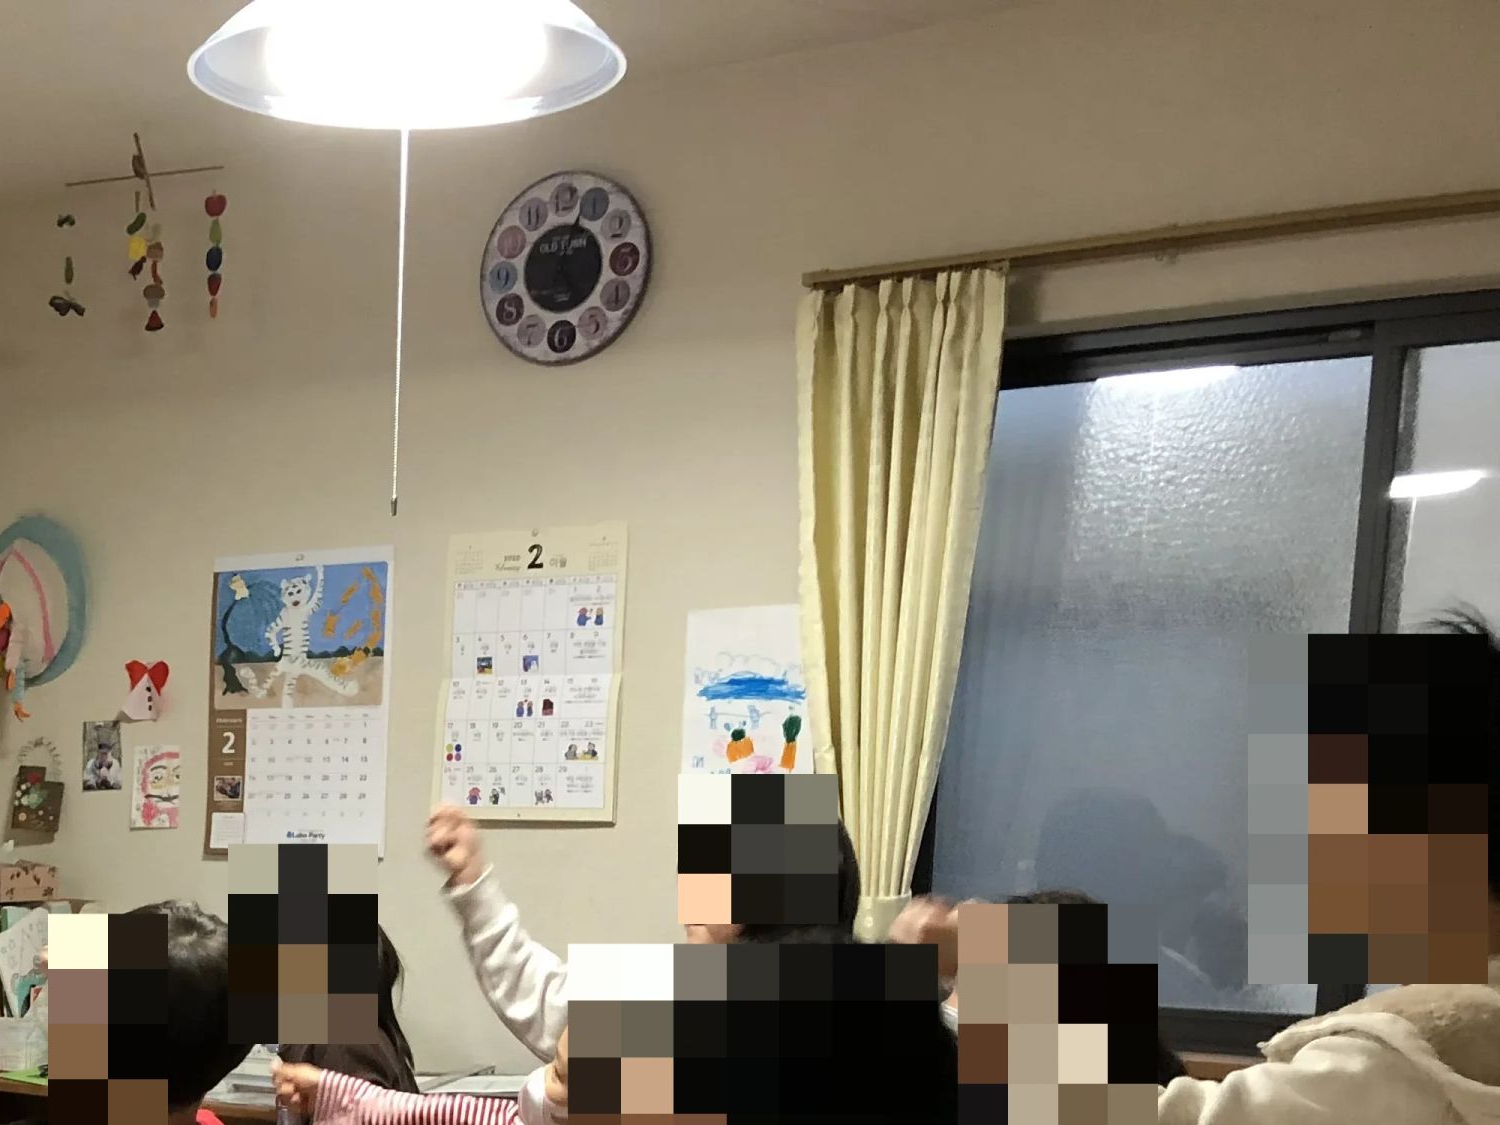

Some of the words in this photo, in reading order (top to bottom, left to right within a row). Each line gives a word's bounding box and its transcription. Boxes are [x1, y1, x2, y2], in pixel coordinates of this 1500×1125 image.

[527, 206, 540, 226] 11
[504, 304, 518, 320] 8
[525, 323, 539, 346] 7
[554, 330, 568, 348] 6
[527, 544, 544, 569] 2
[221, 731, 236, 754] 2
